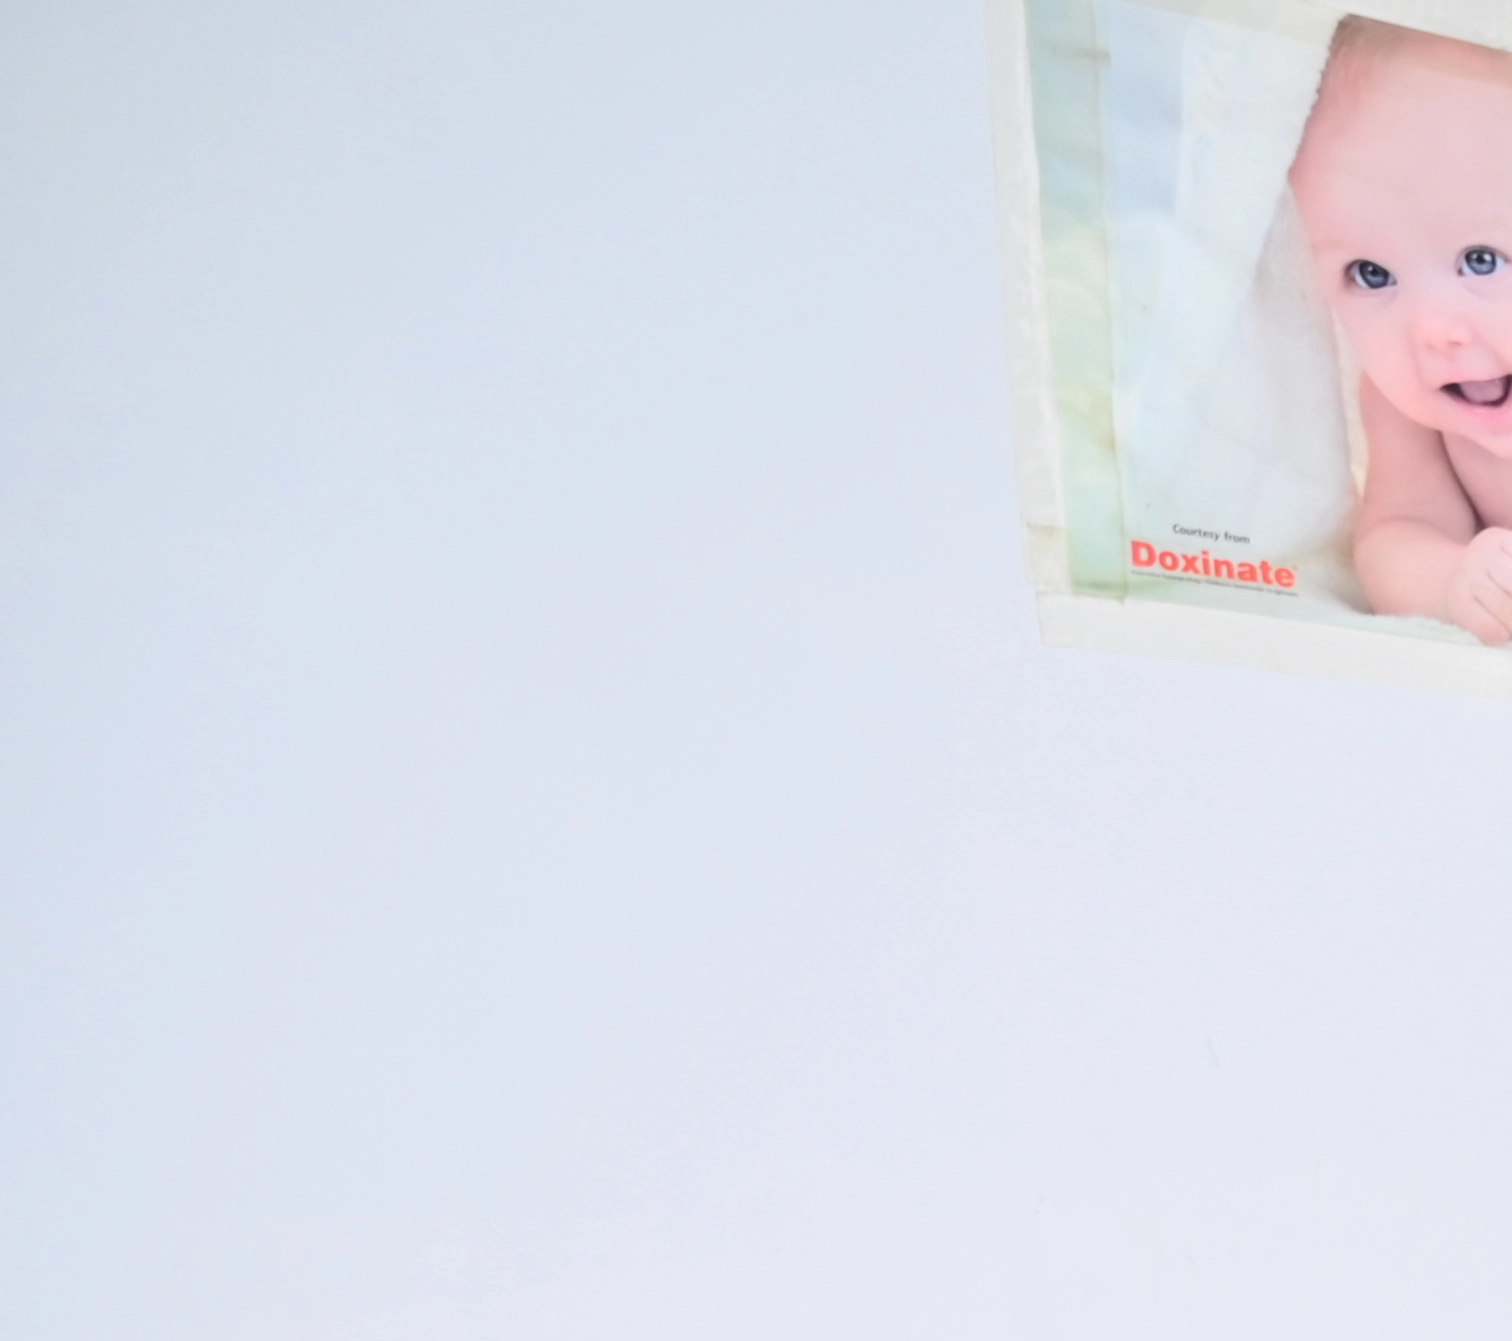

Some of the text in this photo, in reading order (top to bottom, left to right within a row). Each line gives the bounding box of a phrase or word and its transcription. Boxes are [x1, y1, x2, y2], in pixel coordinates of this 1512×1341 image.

[1173, 524, 1250, 544] Courtesy from
[1131, 540, 1296, 588] Doxinate
